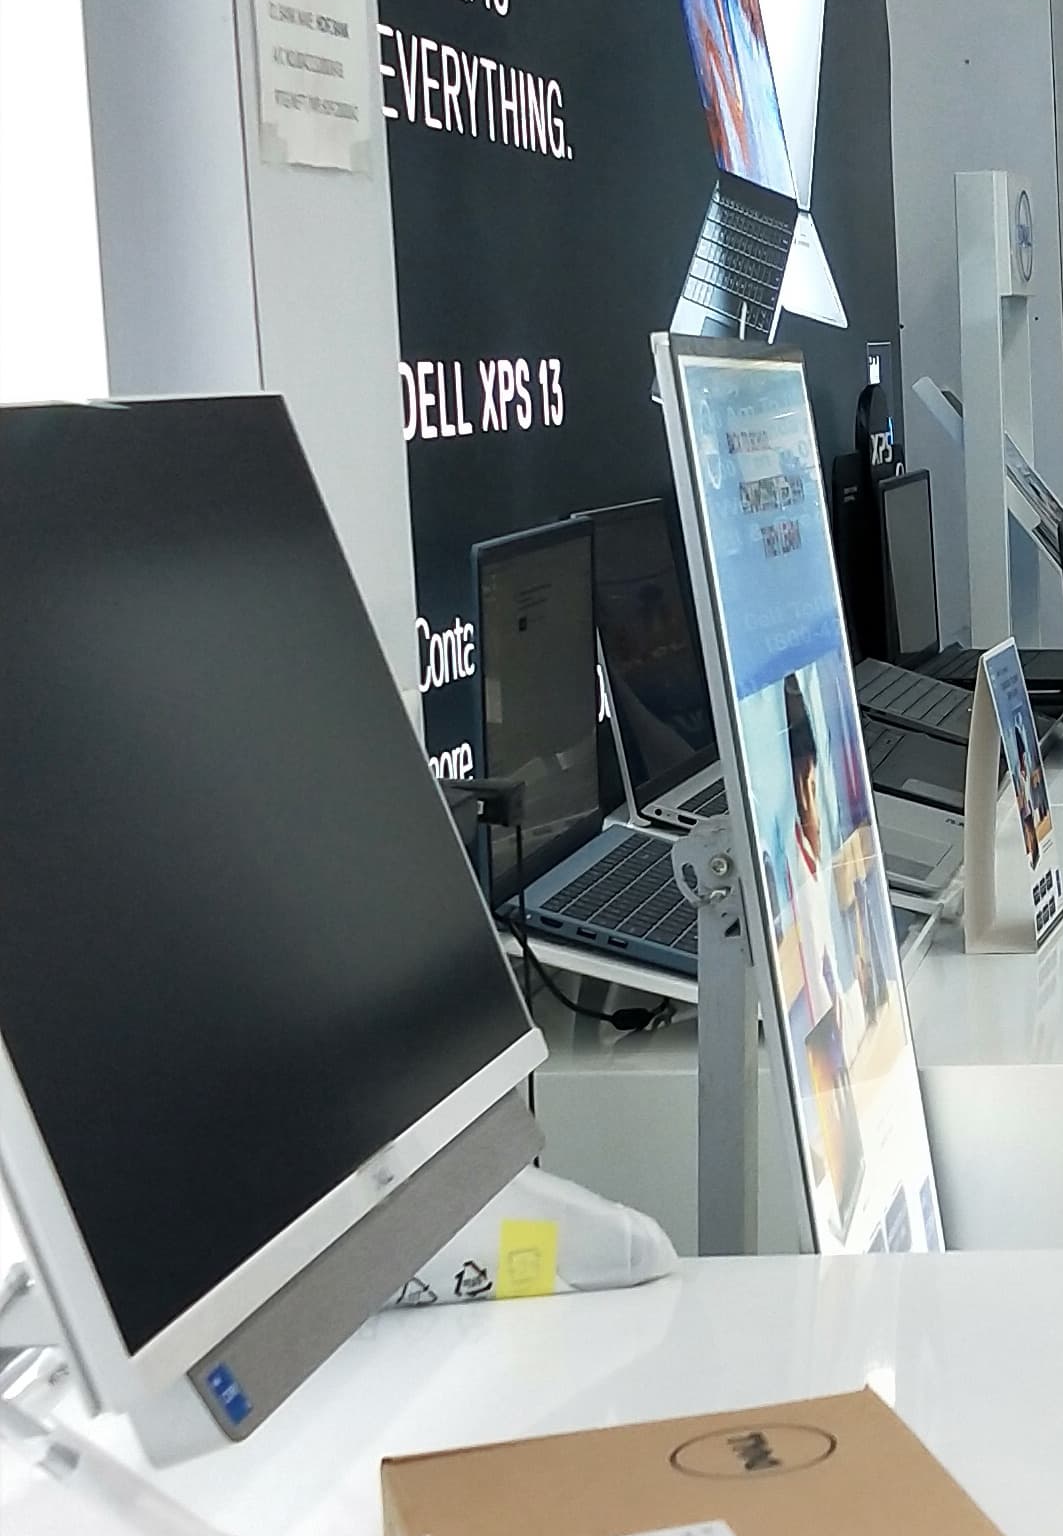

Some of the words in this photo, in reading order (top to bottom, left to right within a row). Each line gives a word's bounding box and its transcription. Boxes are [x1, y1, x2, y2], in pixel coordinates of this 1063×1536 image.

[376, 22, 573, 161] EVERYTHING.
[399, 361, 473, 441] DELL
[478, 358, 533, 433] XPS
[539, 357, 565, 428] 13
[870, 431, 893, 466] XPS
